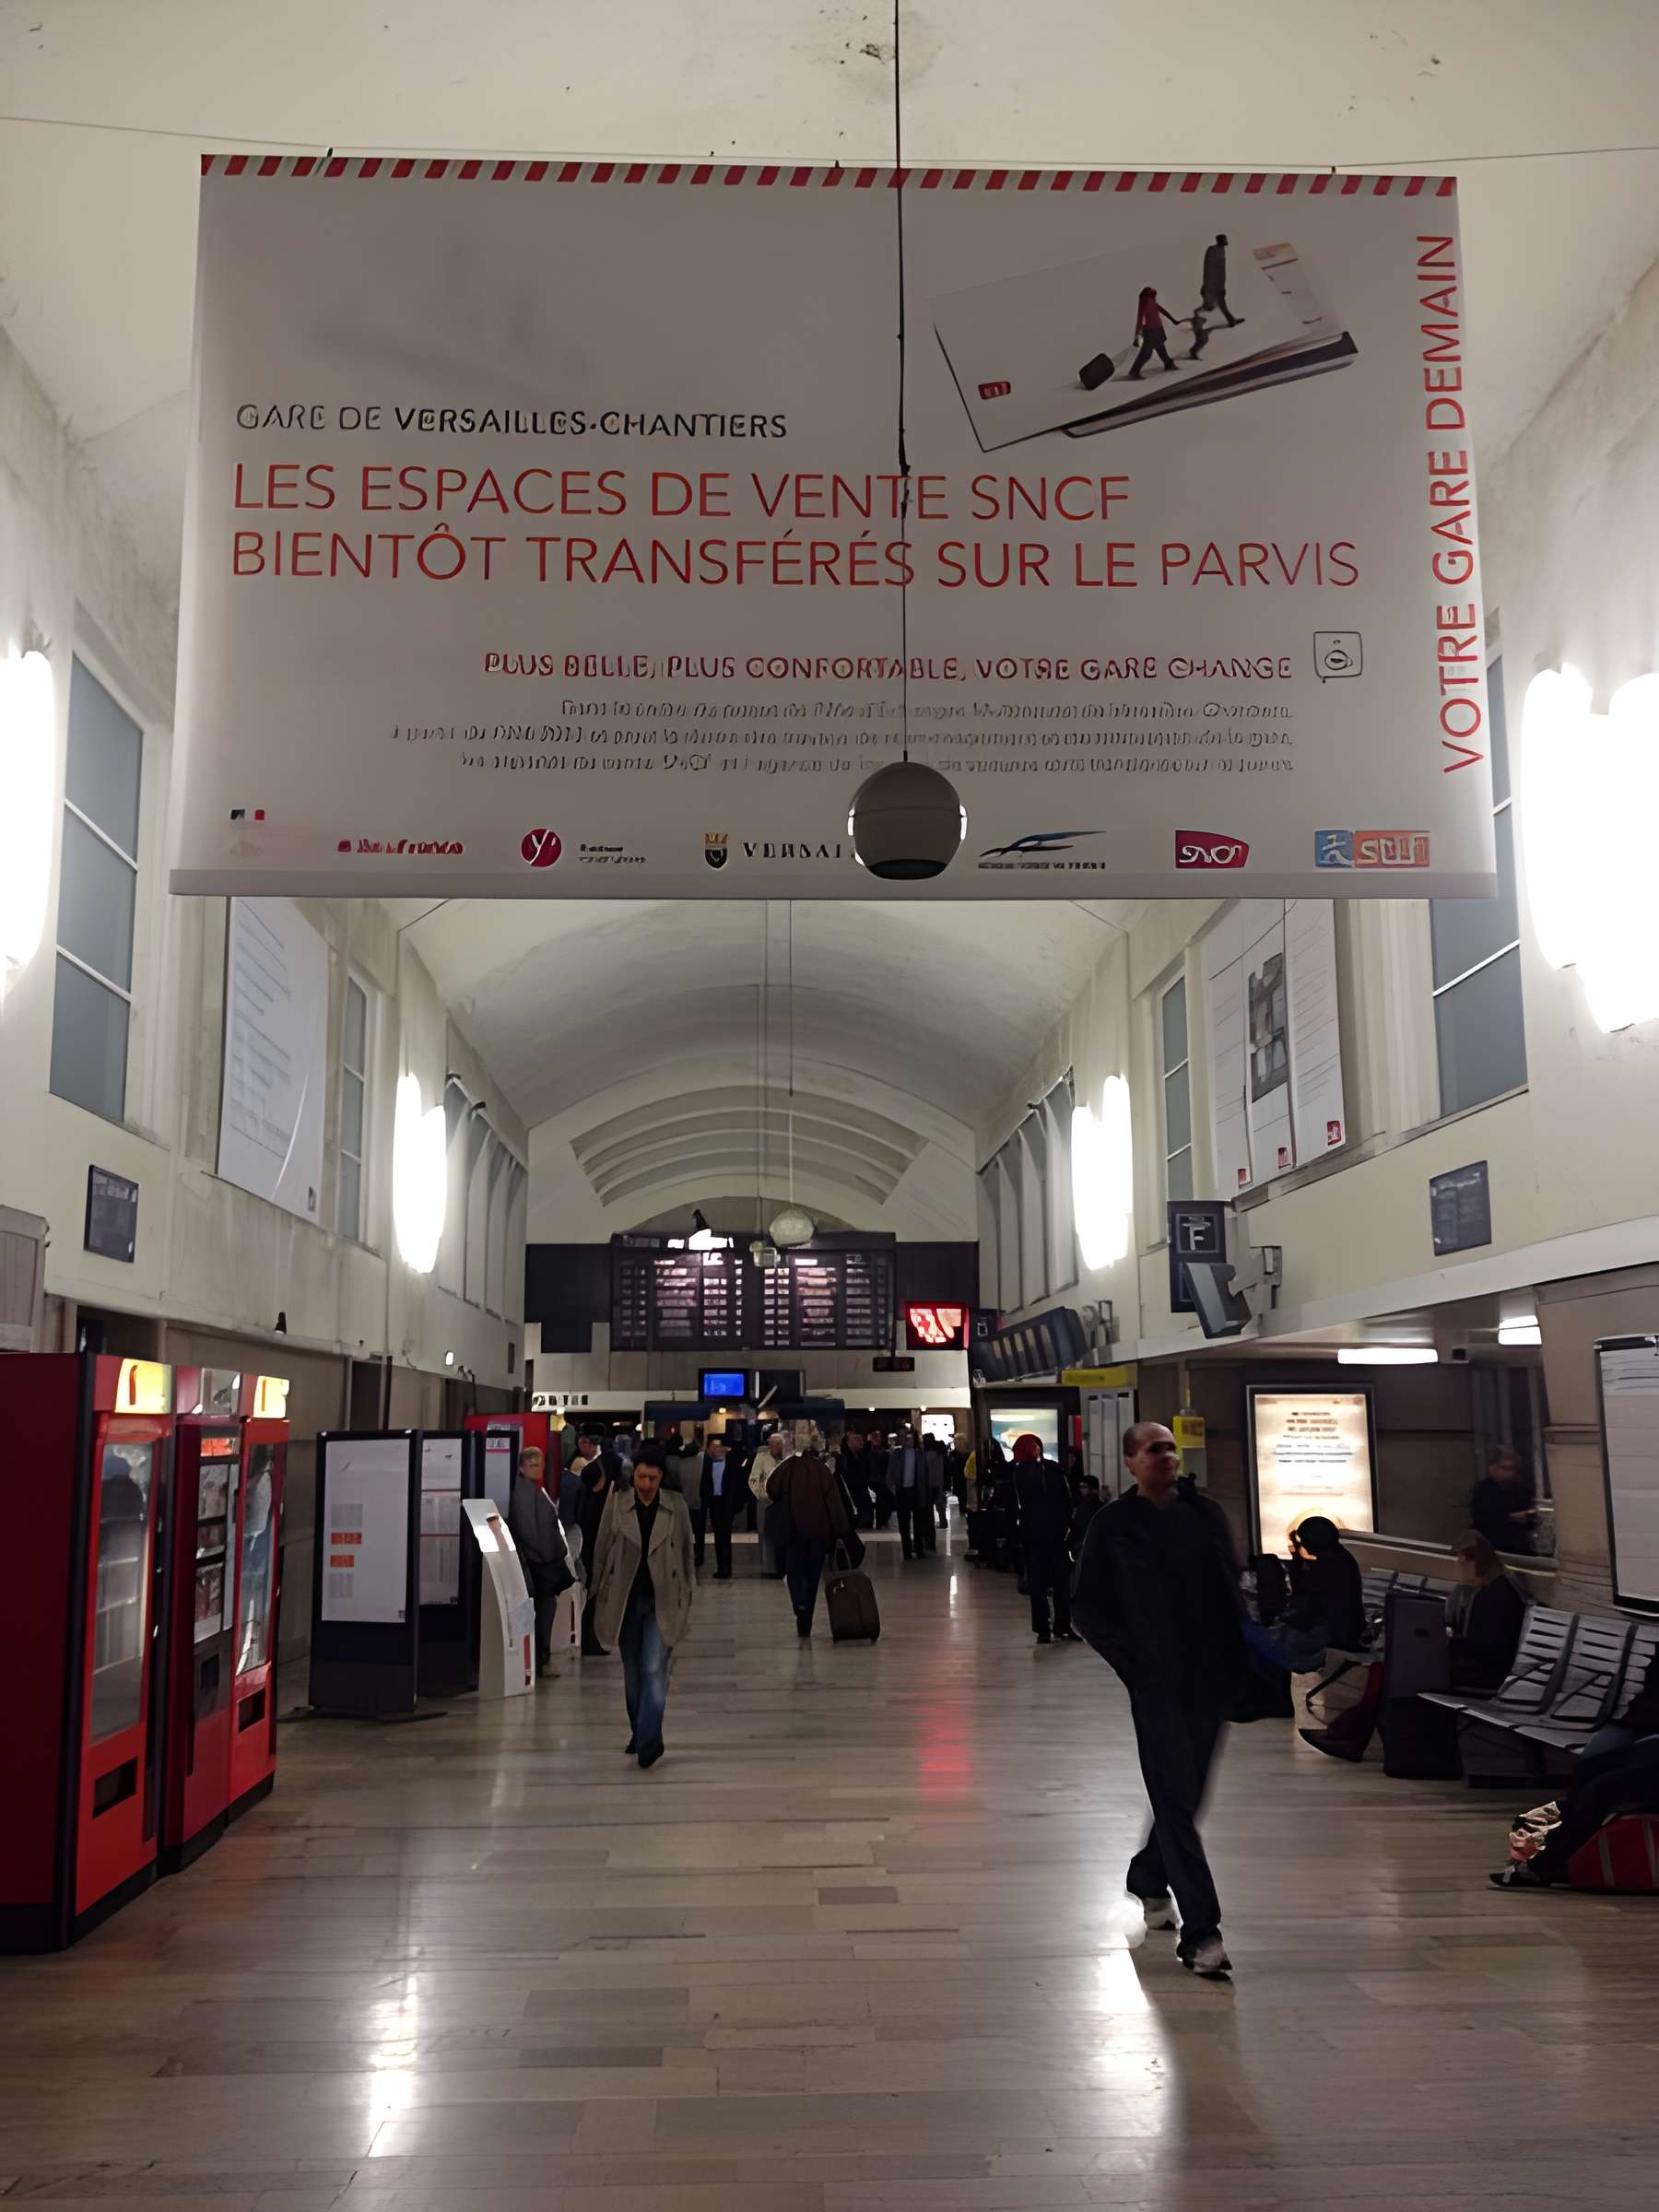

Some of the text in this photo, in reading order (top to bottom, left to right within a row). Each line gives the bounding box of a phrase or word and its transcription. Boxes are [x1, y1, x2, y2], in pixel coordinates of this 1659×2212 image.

[236, 404, 325, 430] GARE
[338, 406, 382, 431] DE
[232, 462, 1133, 521] LES ESPACES DE VENTE SNCF
[1416, 235, 1484, 774] VOTRE GARE DEMAIN
[231, 522, 1359, 590] BIENTÔT TRANSFÉRÉS SUR LE PARVIS
[484, 652, 554, 677] PLUS
[1078, 656, 1159, 682] GARE
[1168, 656, 1293, 681] CHANGE
